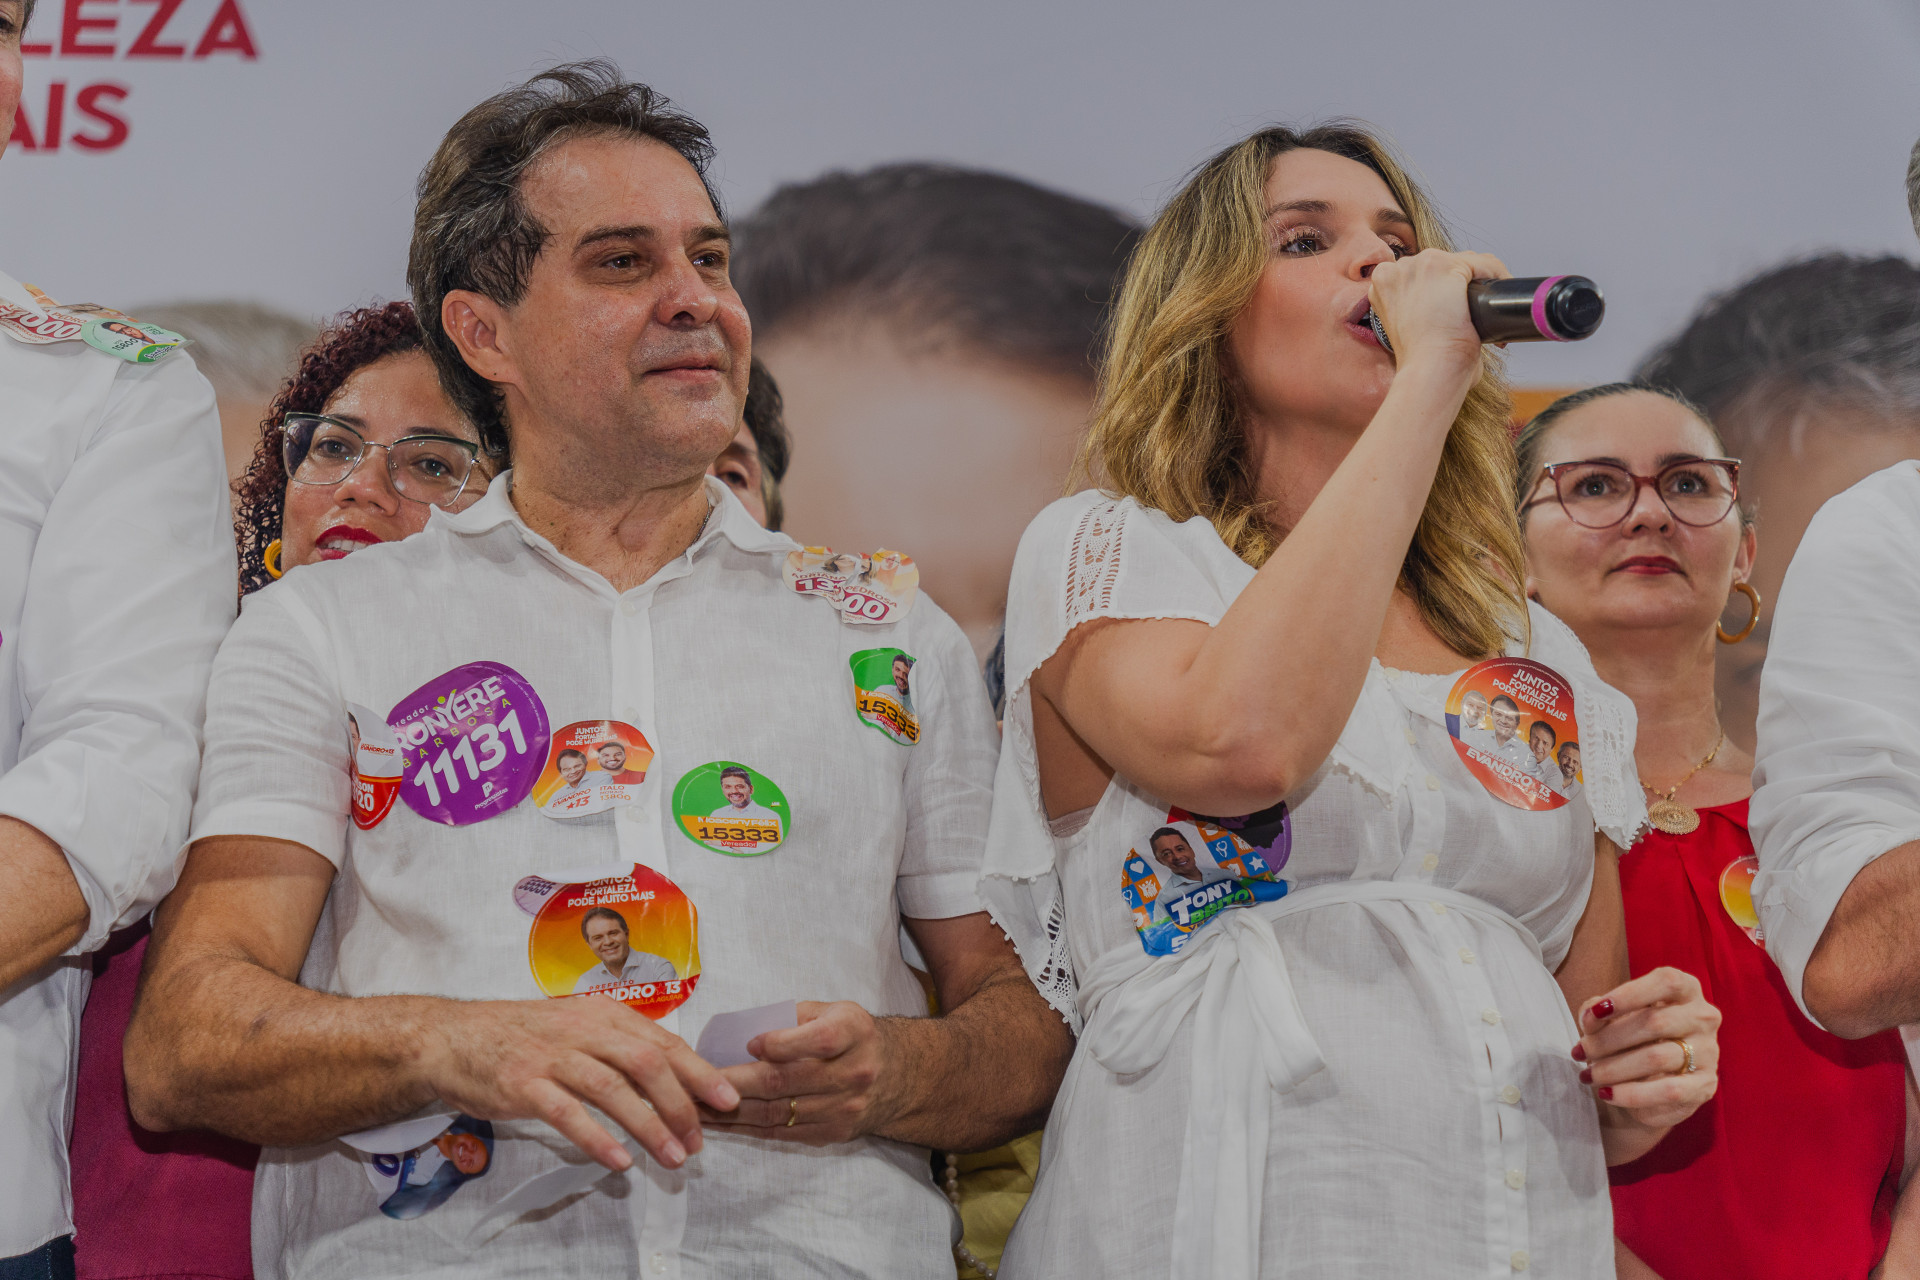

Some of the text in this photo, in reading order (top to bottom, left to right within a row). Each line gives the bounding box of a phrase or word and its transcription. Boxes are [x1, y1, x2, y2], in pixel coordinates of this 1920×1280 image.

[798, 577, 886, 619] 1300
[1492, 678, 1517, 697] PODE
[1517, 691, 1546, 711] MUITO
[1545, 702, 1568, 722] MAIS
[1513, 669, 1560, 699] JUNTOS,
[402, 697, 512, 768] BARBOSA
[858, 699, 920, 741] 15333
[413, 708, 527, 807] 11131
[1466, 746, 1552, 798] EVANDRO 13
[575, 796, 591, 808] 13
[698, 826, 780, 843] 15333
[567, 890, 656, 908] PODE MUITO MAIS
[1170, 880, 1233, 926] TONY
[1190, 888, 1250, 924] BRITO
[589, 980, 634, 992] PREFEITO
[664, 981, 681, 994] 13
